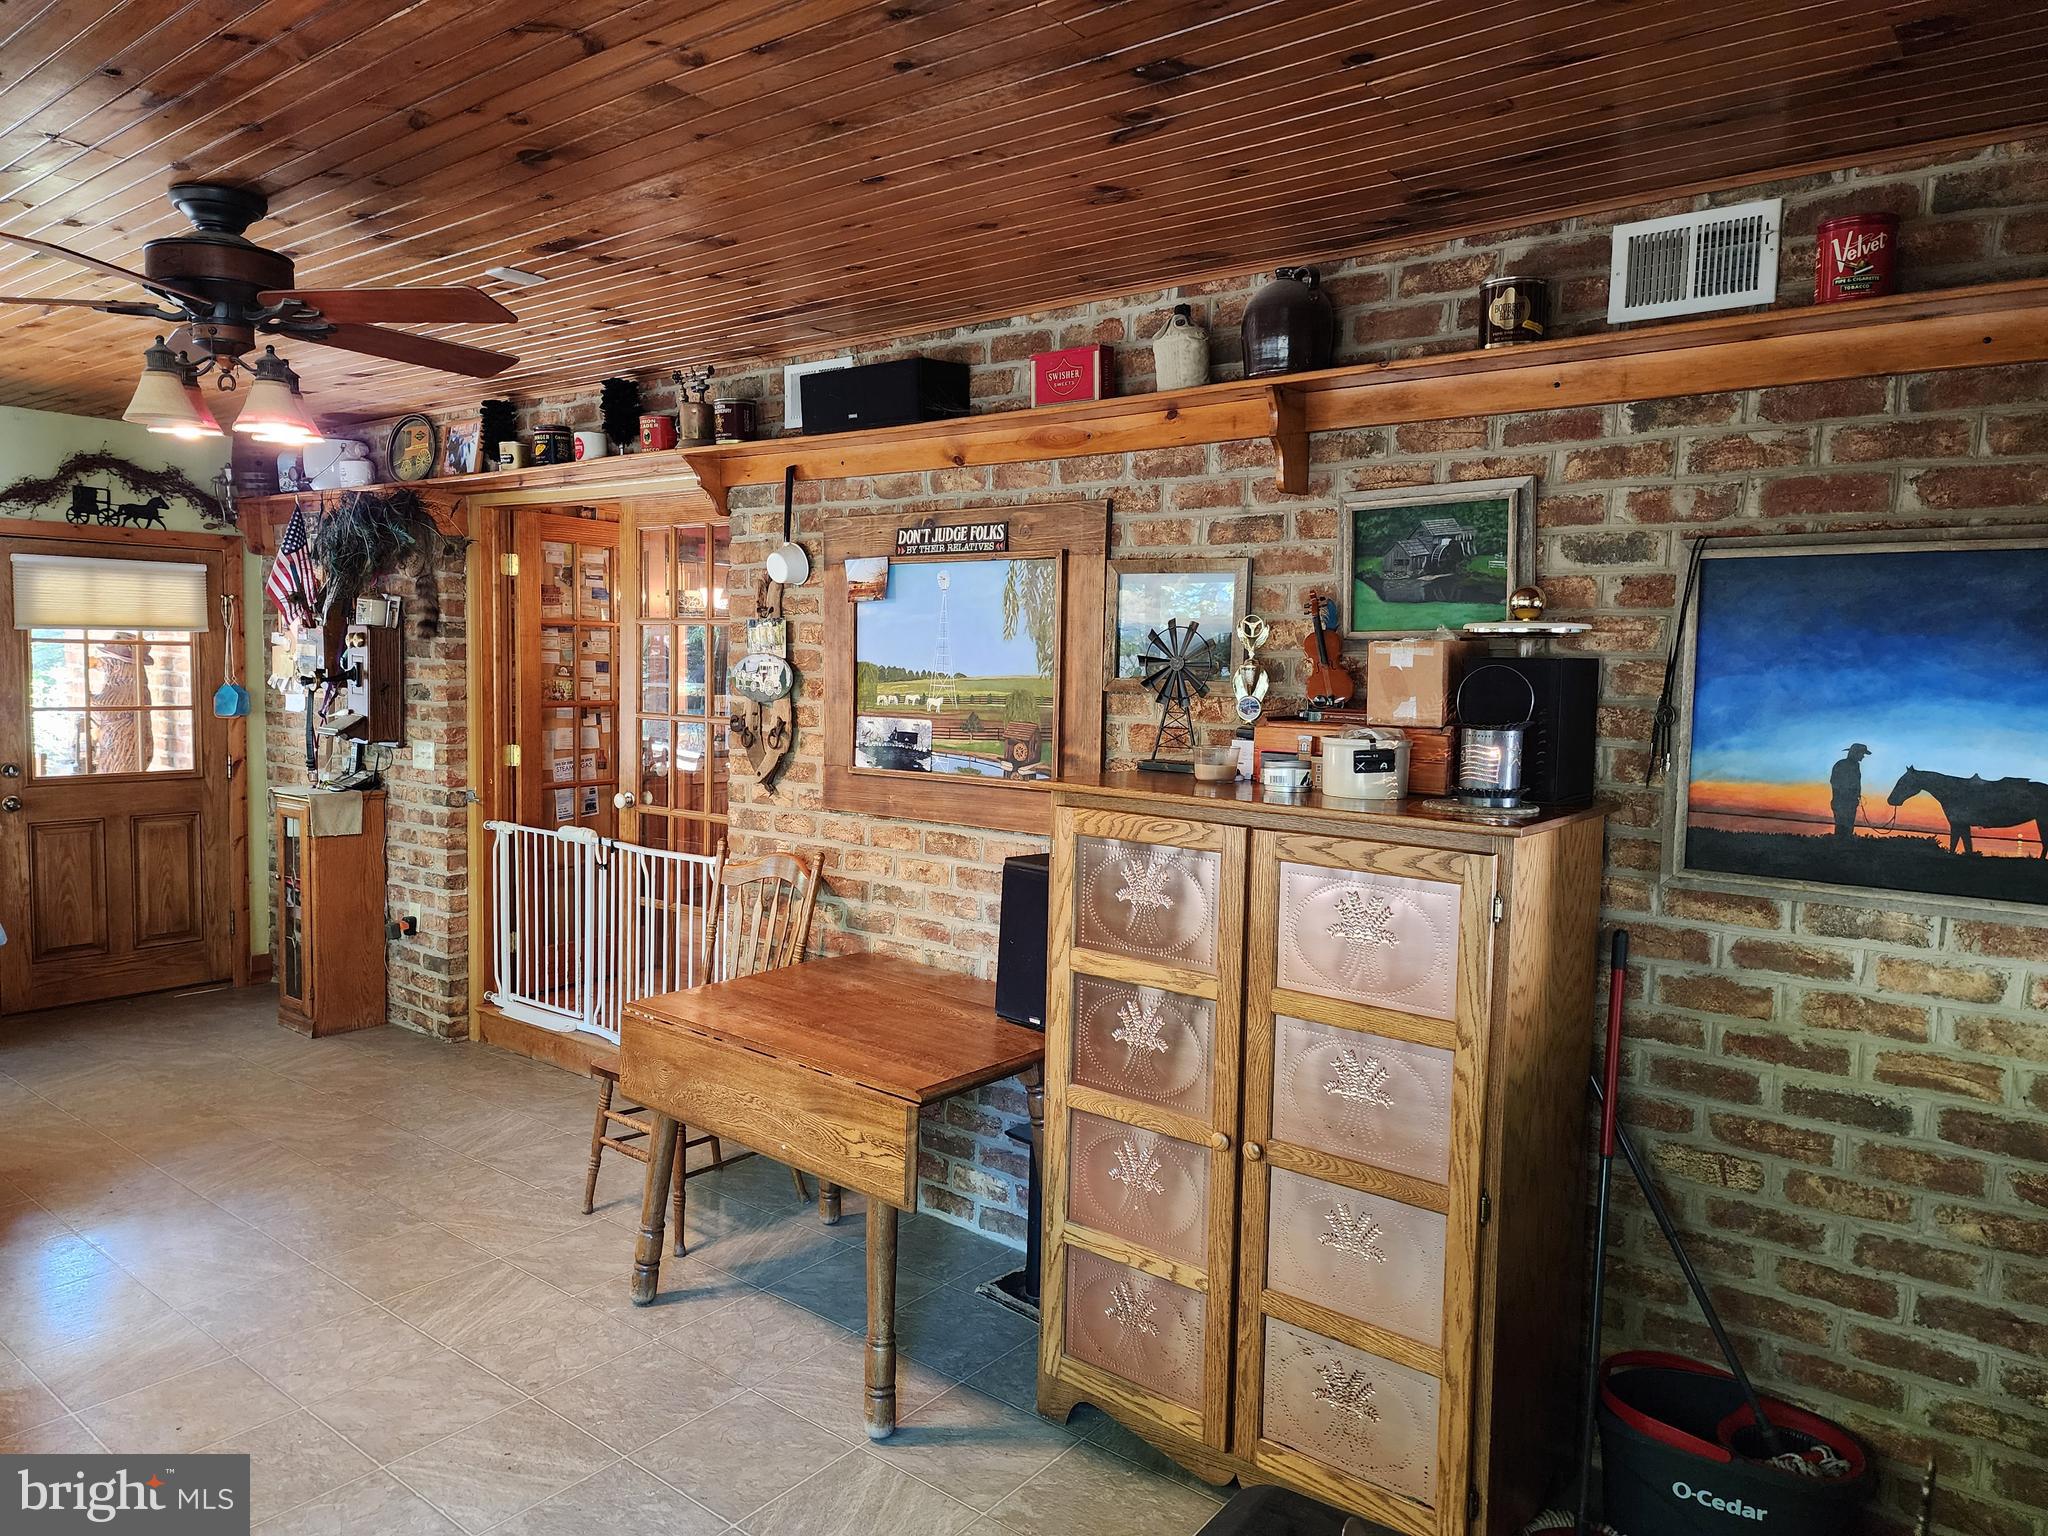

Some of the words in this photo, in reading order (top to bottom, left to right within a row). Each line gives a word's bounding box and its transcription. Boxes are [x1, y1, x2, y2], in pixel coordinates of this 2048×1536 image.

[1831, 231, 1888, 273] Velvet
[1048, 369, 1080, 382] SWISHER
[1053, 380, 1075, 388] SWEETS
[898, 528, 931, 545] DON'T
[931, 526, 968, 543] JUDGE
[970, 523, 1005, 541] FOLKS
[906, 545, 917, 554] BY
[919, 543, 945, 553] THEIR
[947, 541, 995, 552] RELATIVES
[1672, 1481, 1768, 1521] O-Cedar
